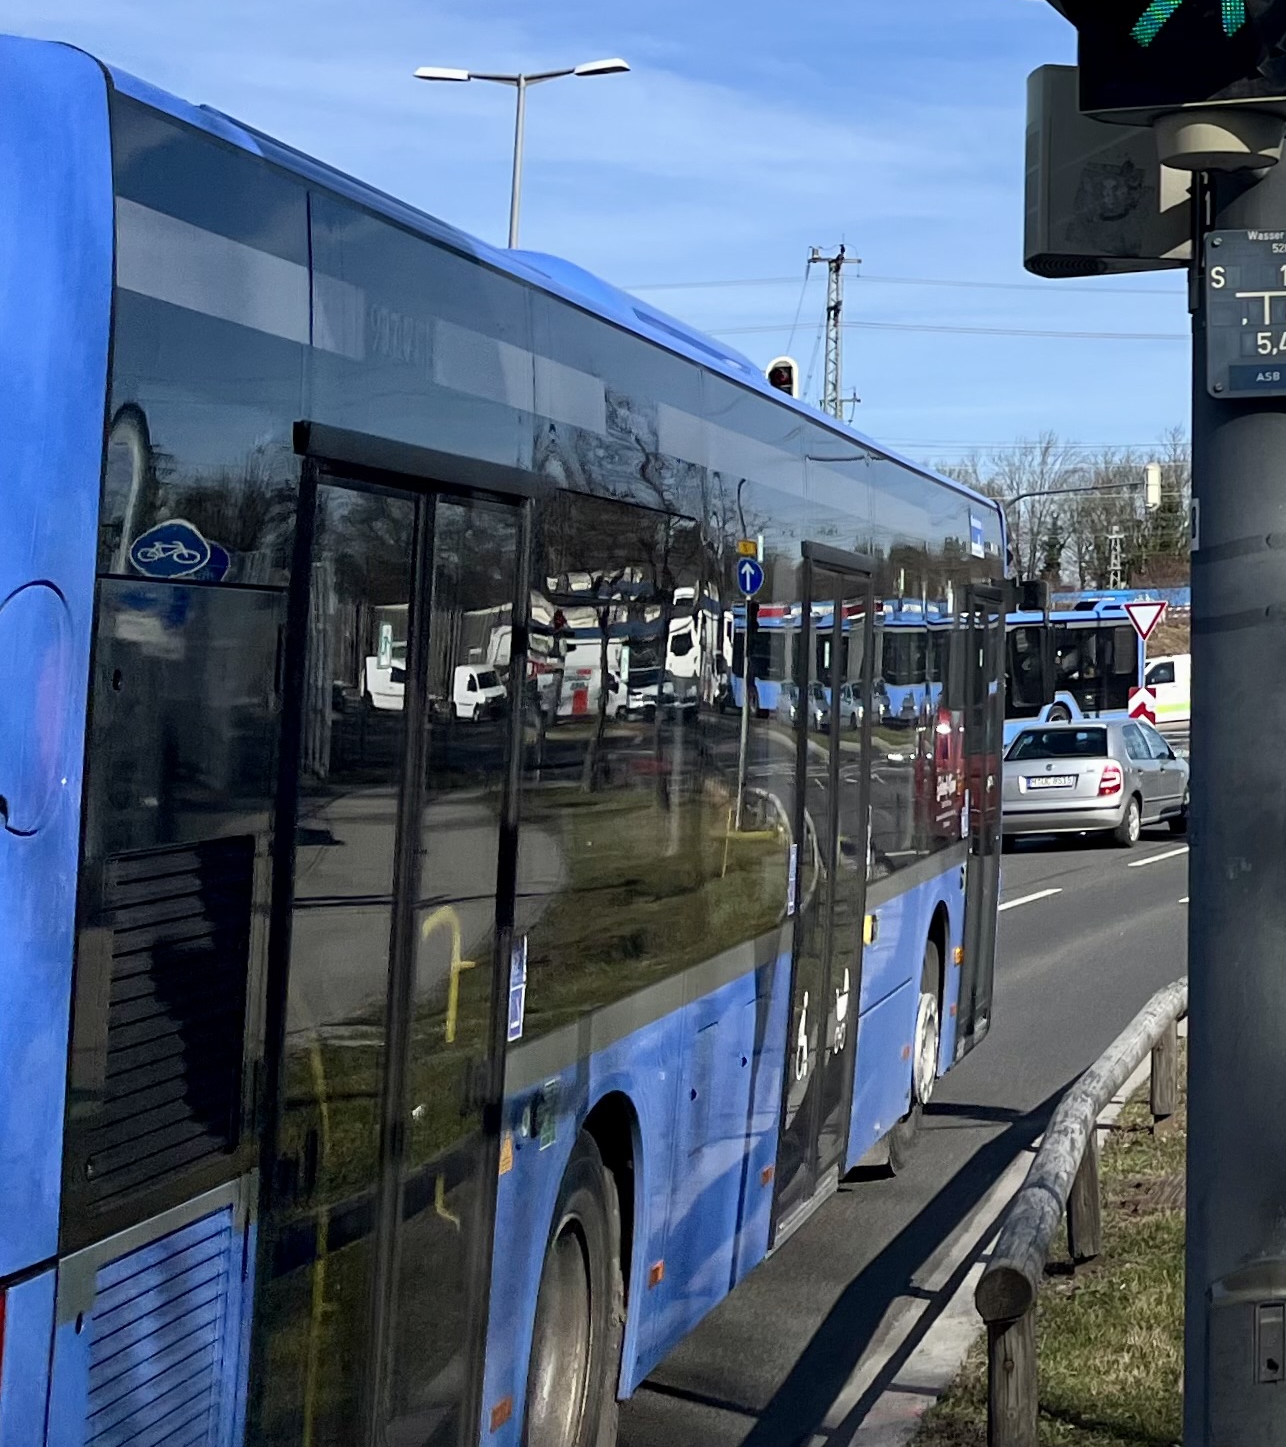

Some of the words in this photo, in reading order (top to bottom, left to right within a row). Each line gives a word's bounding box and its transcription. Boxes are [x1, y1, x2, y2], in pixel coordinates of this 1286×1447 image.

[1247, 230, 1285, 241] Wasser
[1210, 266, 1226, 289] S
[1255, 371, 1281, 382] ASB
